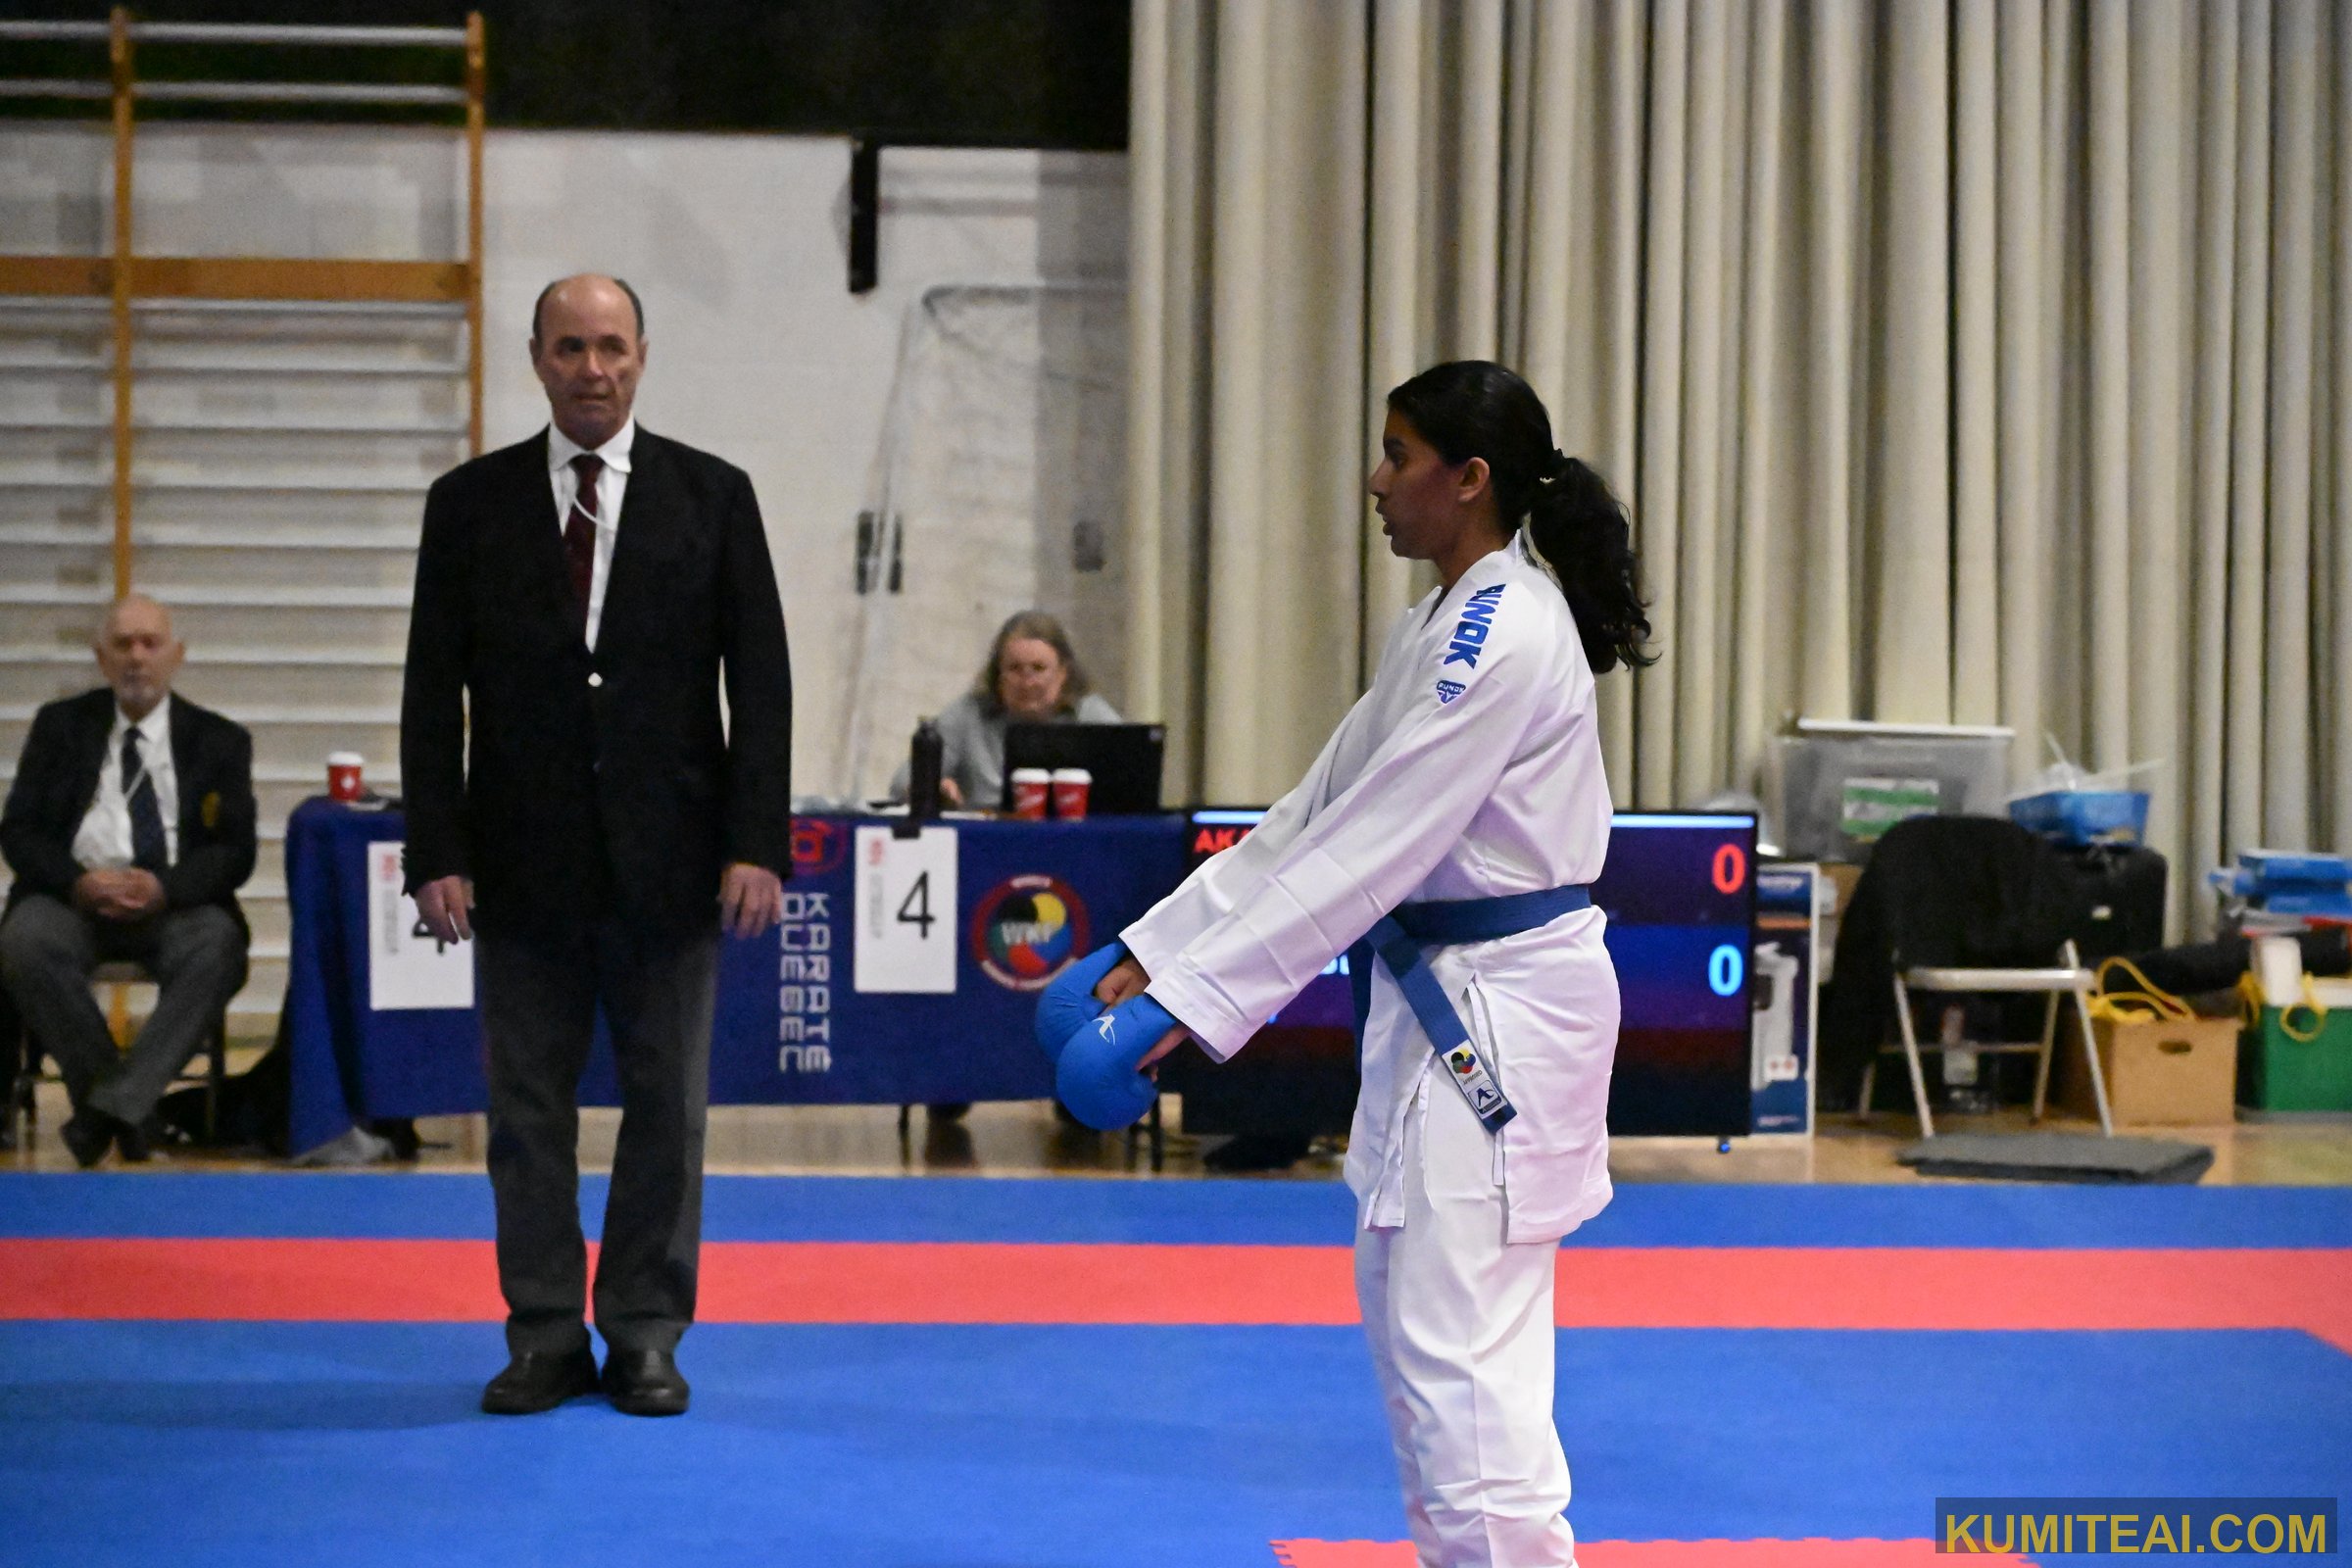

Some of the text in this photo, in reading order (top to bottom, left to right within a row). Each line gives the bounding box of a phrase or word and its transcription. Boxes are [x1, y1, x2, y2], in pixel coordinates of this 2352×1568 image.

[1194, 829, 1251, 853] AK
[1712, 843, 1745, 894] 0
[896, 870, 936, 940] 4
[1708, 944, 1743, 997] 0
